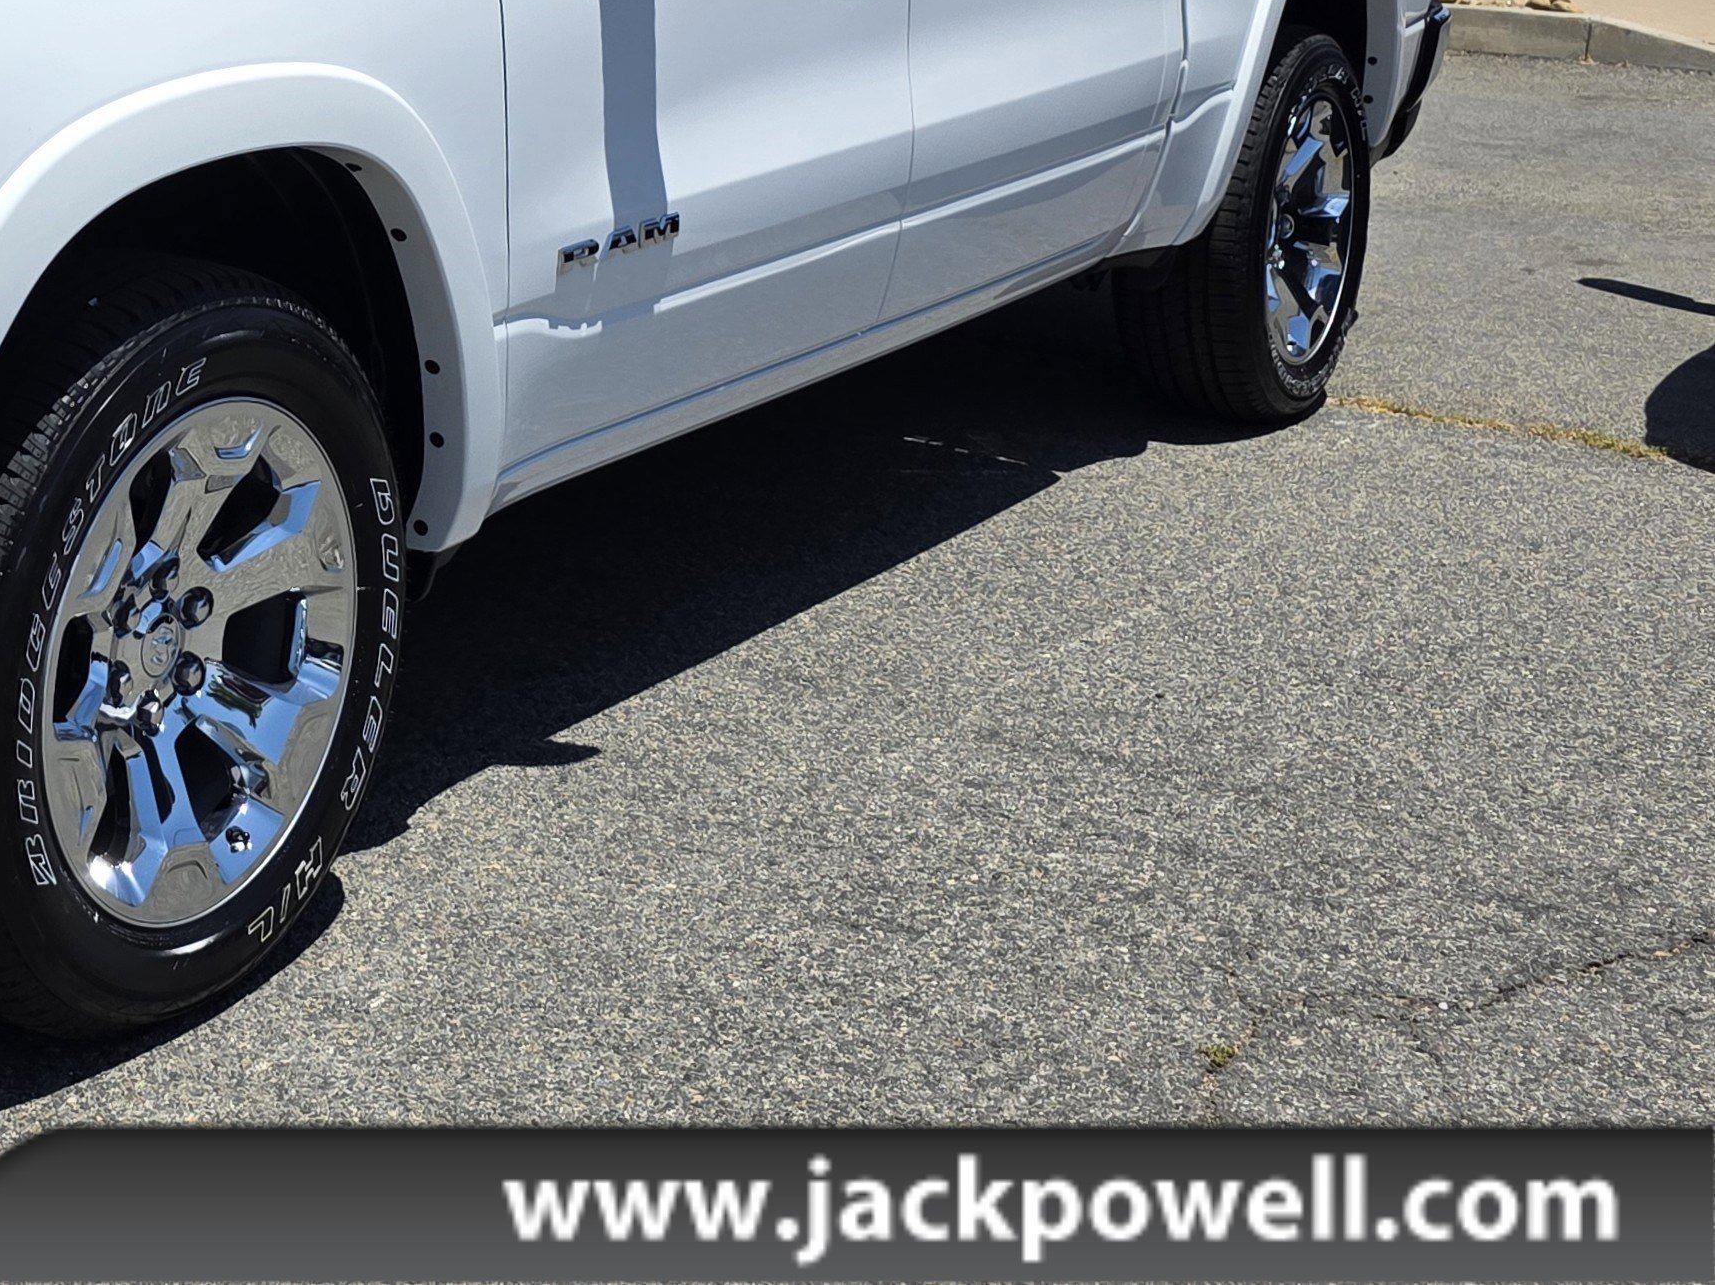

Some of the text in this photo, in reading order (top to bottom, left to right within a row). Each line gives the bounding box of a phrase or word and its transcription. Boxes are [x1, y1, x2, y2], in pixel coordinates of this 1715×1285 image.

[557, 212, 680, 276] RAM
[16, 356, 207, 886] BRIDGESTONE
[339, 477, 402, 812] DUELER
